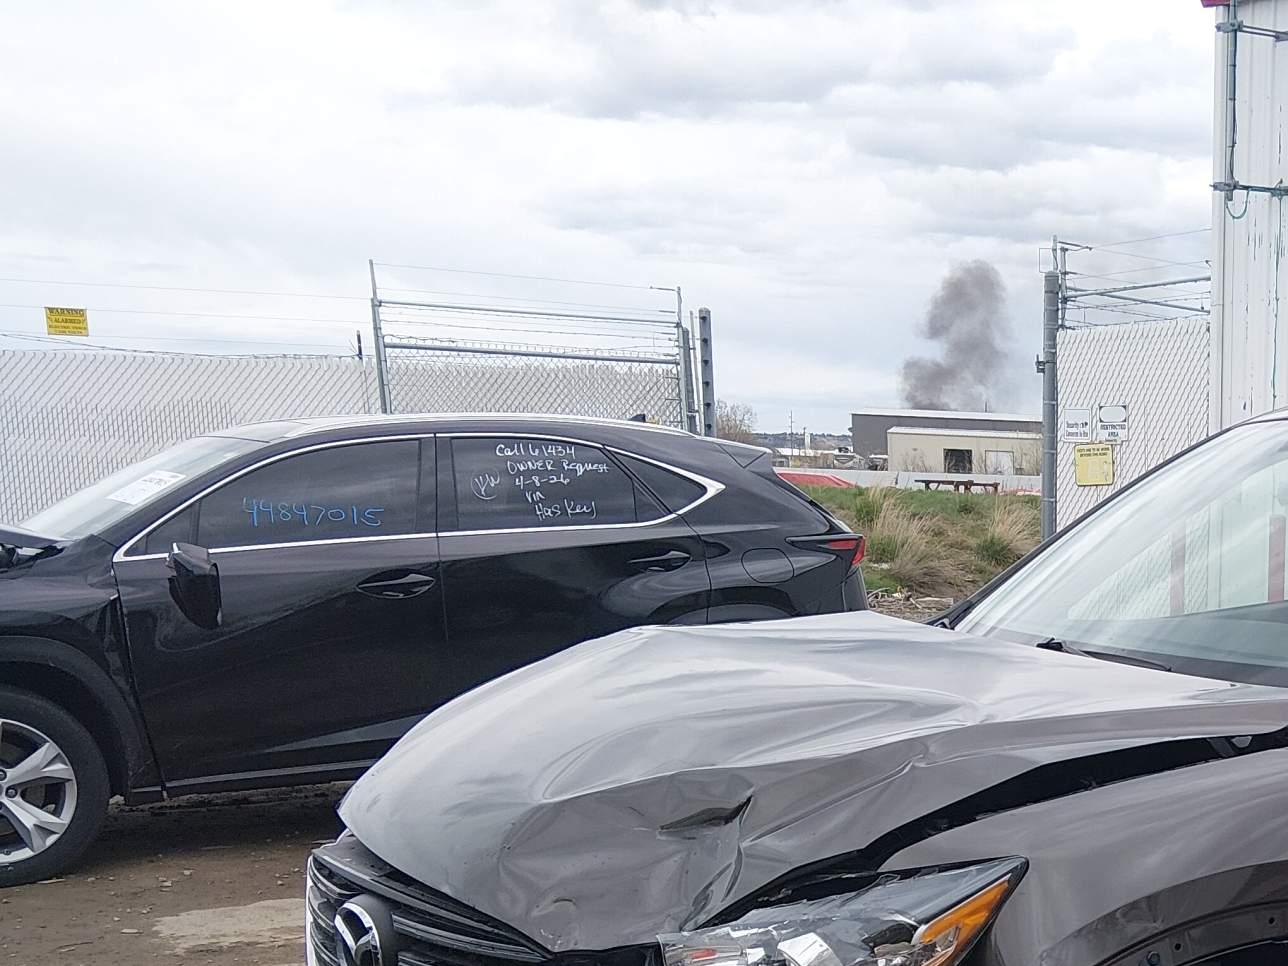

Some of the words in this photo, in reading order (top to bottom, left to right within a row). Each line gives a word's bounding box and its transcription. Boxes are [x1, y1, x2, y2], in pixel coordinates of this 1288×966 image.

[48, 308, 84, 316] WARNING
[495, 443, 525, 457] Call
[507, 459, 557, 475] OWNER
[242, 496, 385, 527] 44847015
[535, 502, 562, 521] Has
